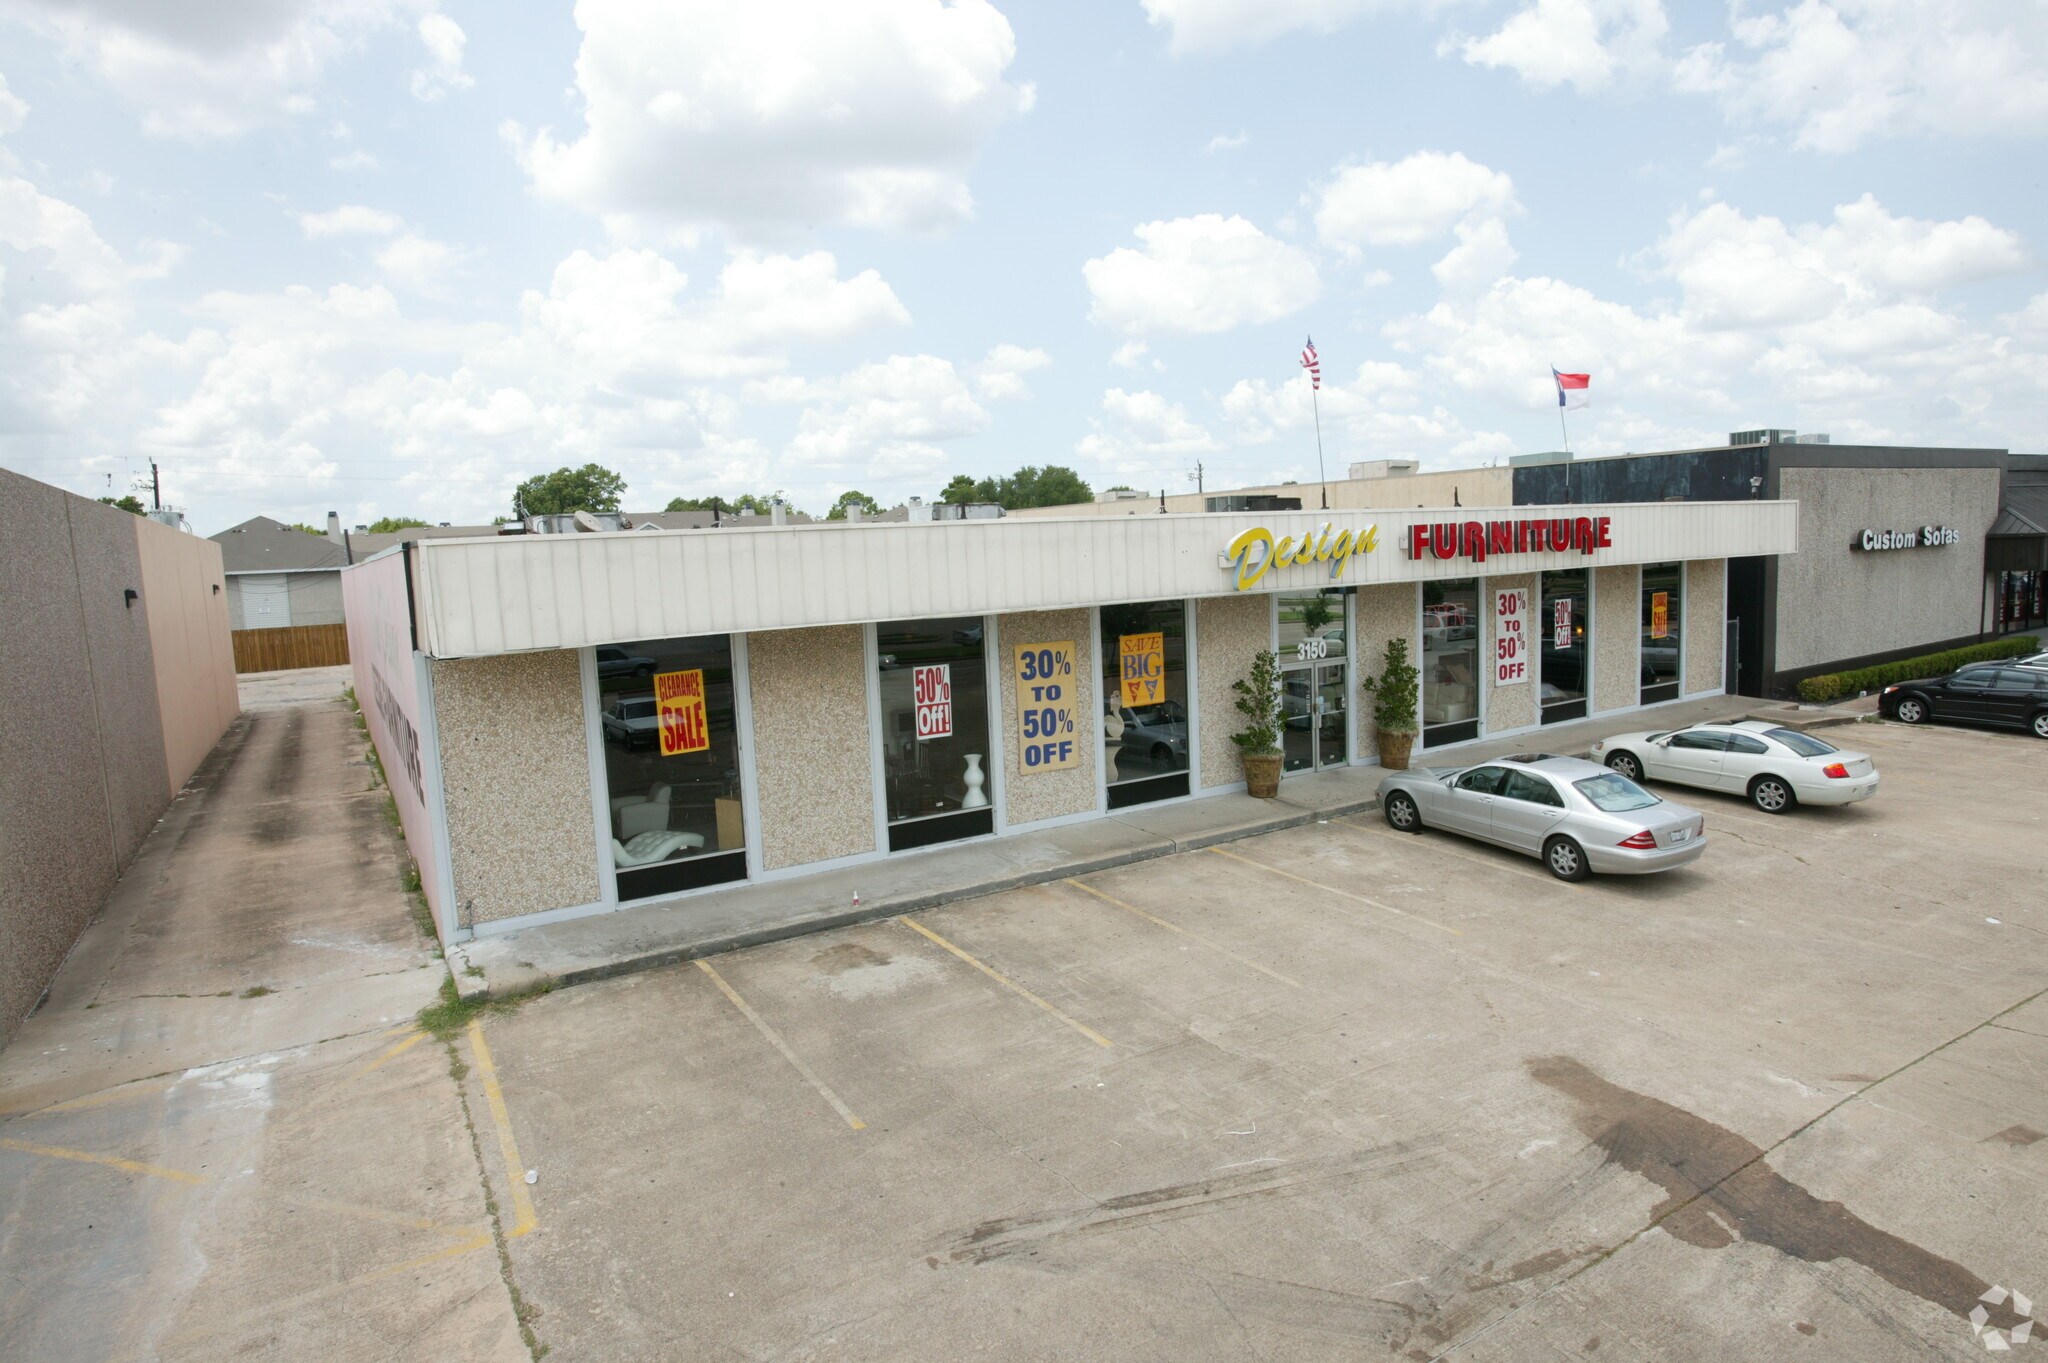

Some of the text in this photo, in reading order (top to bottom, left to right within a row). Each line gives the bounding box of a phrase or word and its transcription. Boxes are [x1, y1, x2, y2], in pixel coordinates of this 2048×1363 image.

[1862, 525, 1960, 551] Custom Sofas
[1224, 516, 1612, 591] Design FURNITURE
[1498, 592, 1526, 616] 30%
[1555, 600, 1571, 625] 50%
[1504, 619, 1521, 632] TO
[1122, 635, 1161, 653] SAVE
[1297, 642, 1327, 660] 3150
[1498, 632, 1526, 660] 50%
[1020, 649, 1071, 681] 30%
[1122, 651, 1163, 680] BIG
[1499, 662, 1525, 681] OFF
[658, 672, 701, 702] CLEARANCE
[915, 666, 950, 704] 50%
[1031, 684, 1062, 702] TO
[661, 701, 706, 753] SALE
[918, 704, 950, 734] Off!
[1023, 707, 1074, 739] 50%
[1025, 740, 1073, 767] OFF
